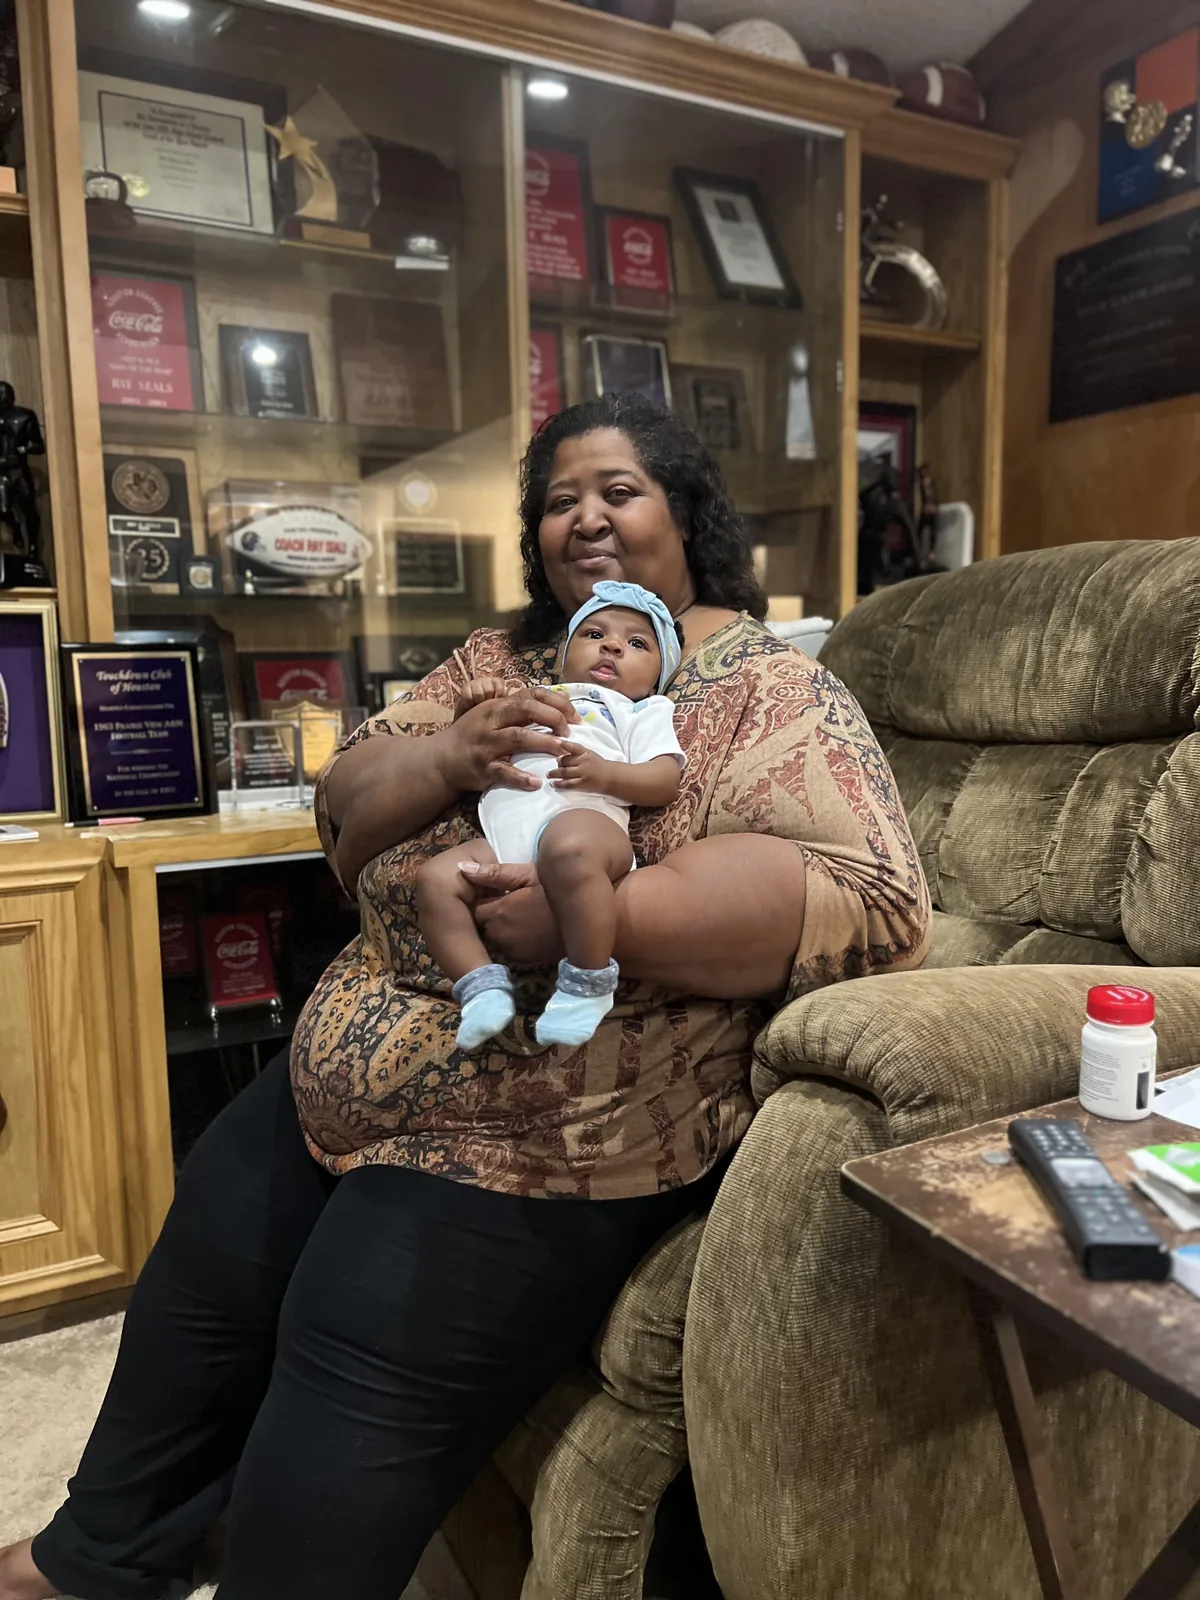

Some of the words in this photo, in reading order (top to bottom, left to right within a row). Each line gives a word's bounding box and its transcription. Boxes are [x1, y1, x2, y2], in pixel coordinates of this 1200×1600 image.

[112, 377, 132, 390] RAY
[138, 380, 174, 394] SEALS
[275, 538, 304, 552] COACH
[96, 670, 149, 681] Touchdown
[150, 669, 172, 680] Club
[110, 683, 122, 696] of
[122, 683, 162, 692] Houston
